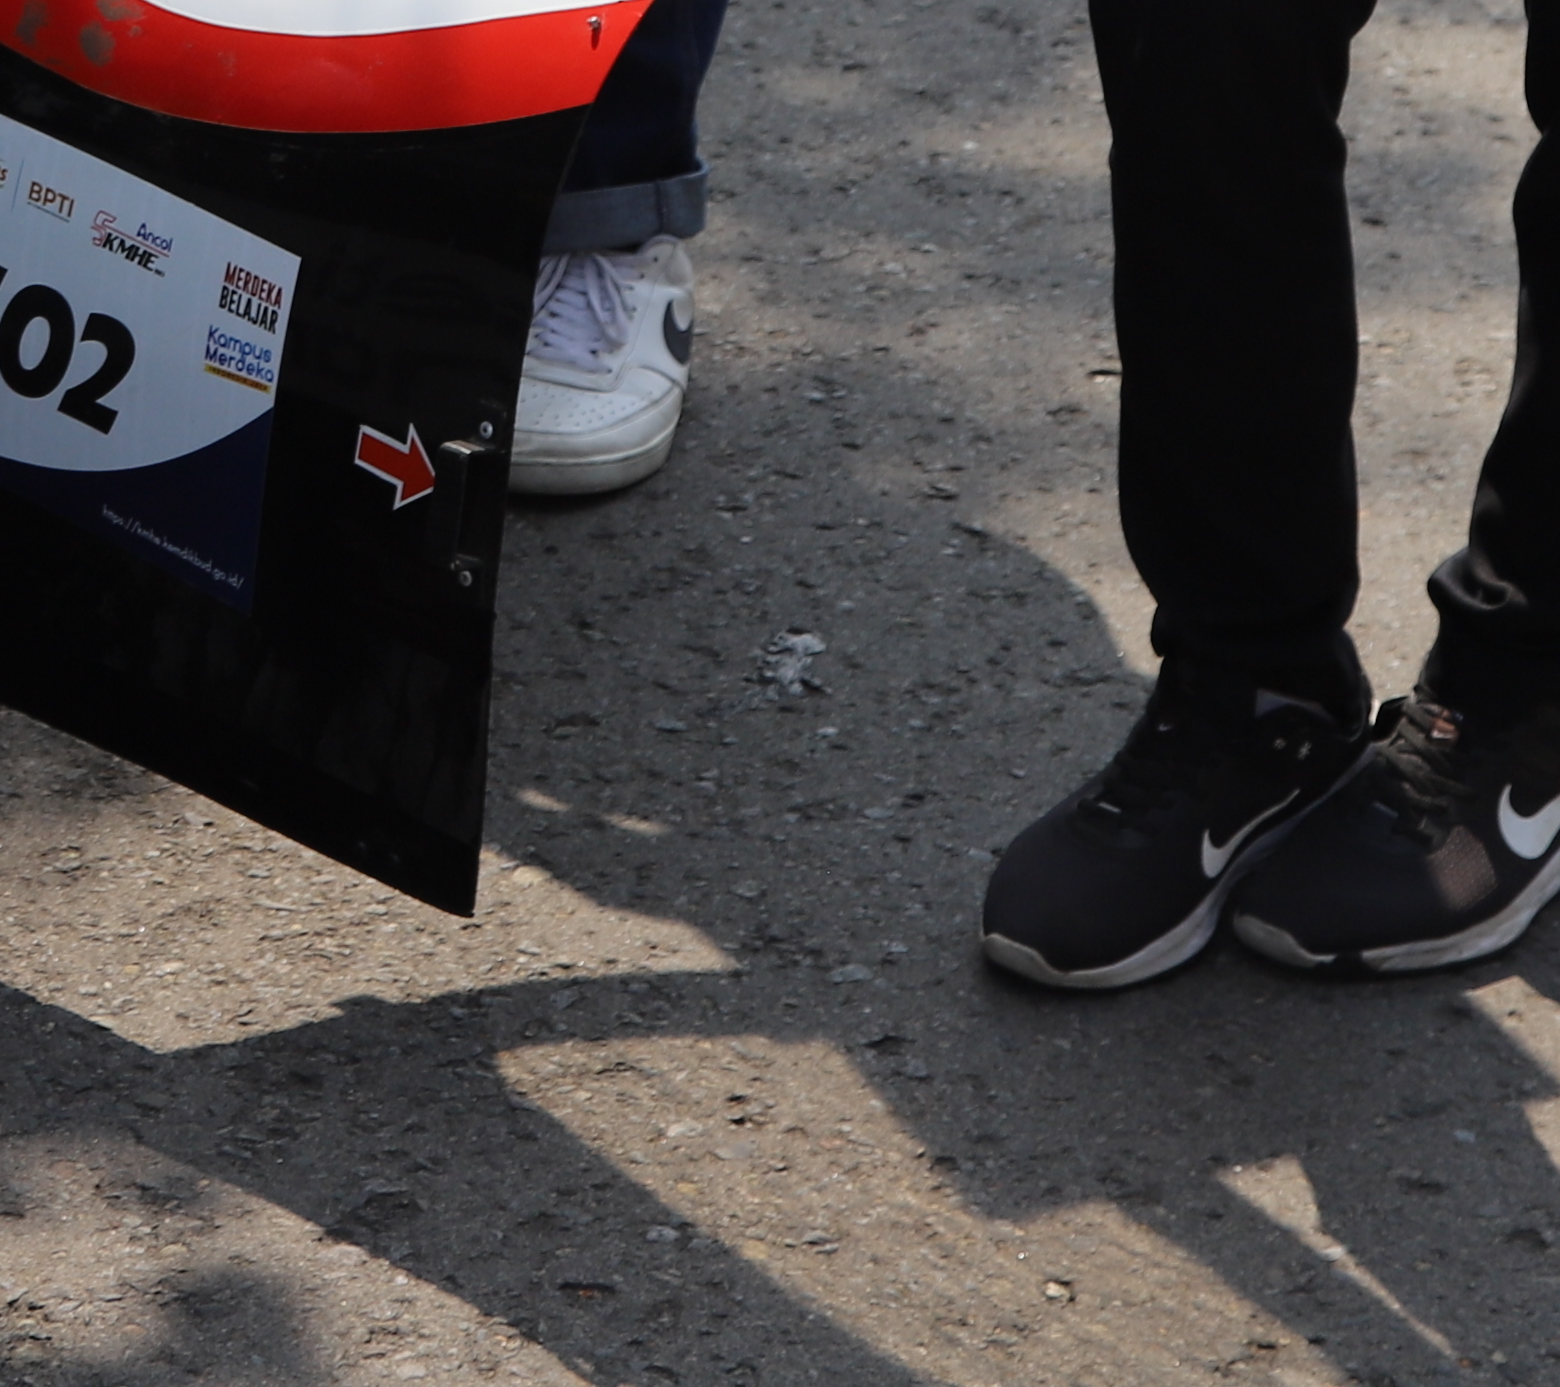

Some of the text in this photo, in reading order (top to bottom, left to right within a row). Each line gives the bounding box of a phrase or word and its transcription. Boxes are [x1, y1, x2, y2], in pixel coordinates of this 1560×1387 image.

[28, 181, 76, 218] BPTI
[136, 223, 174, 252] Ancol
[224, 262, 283, 310] MERDEKA
[219, 285, 278, 334] BELAJAR
[205, 343, 274, 383] Merdeka
[207, 325, 272, 363] Kampus
